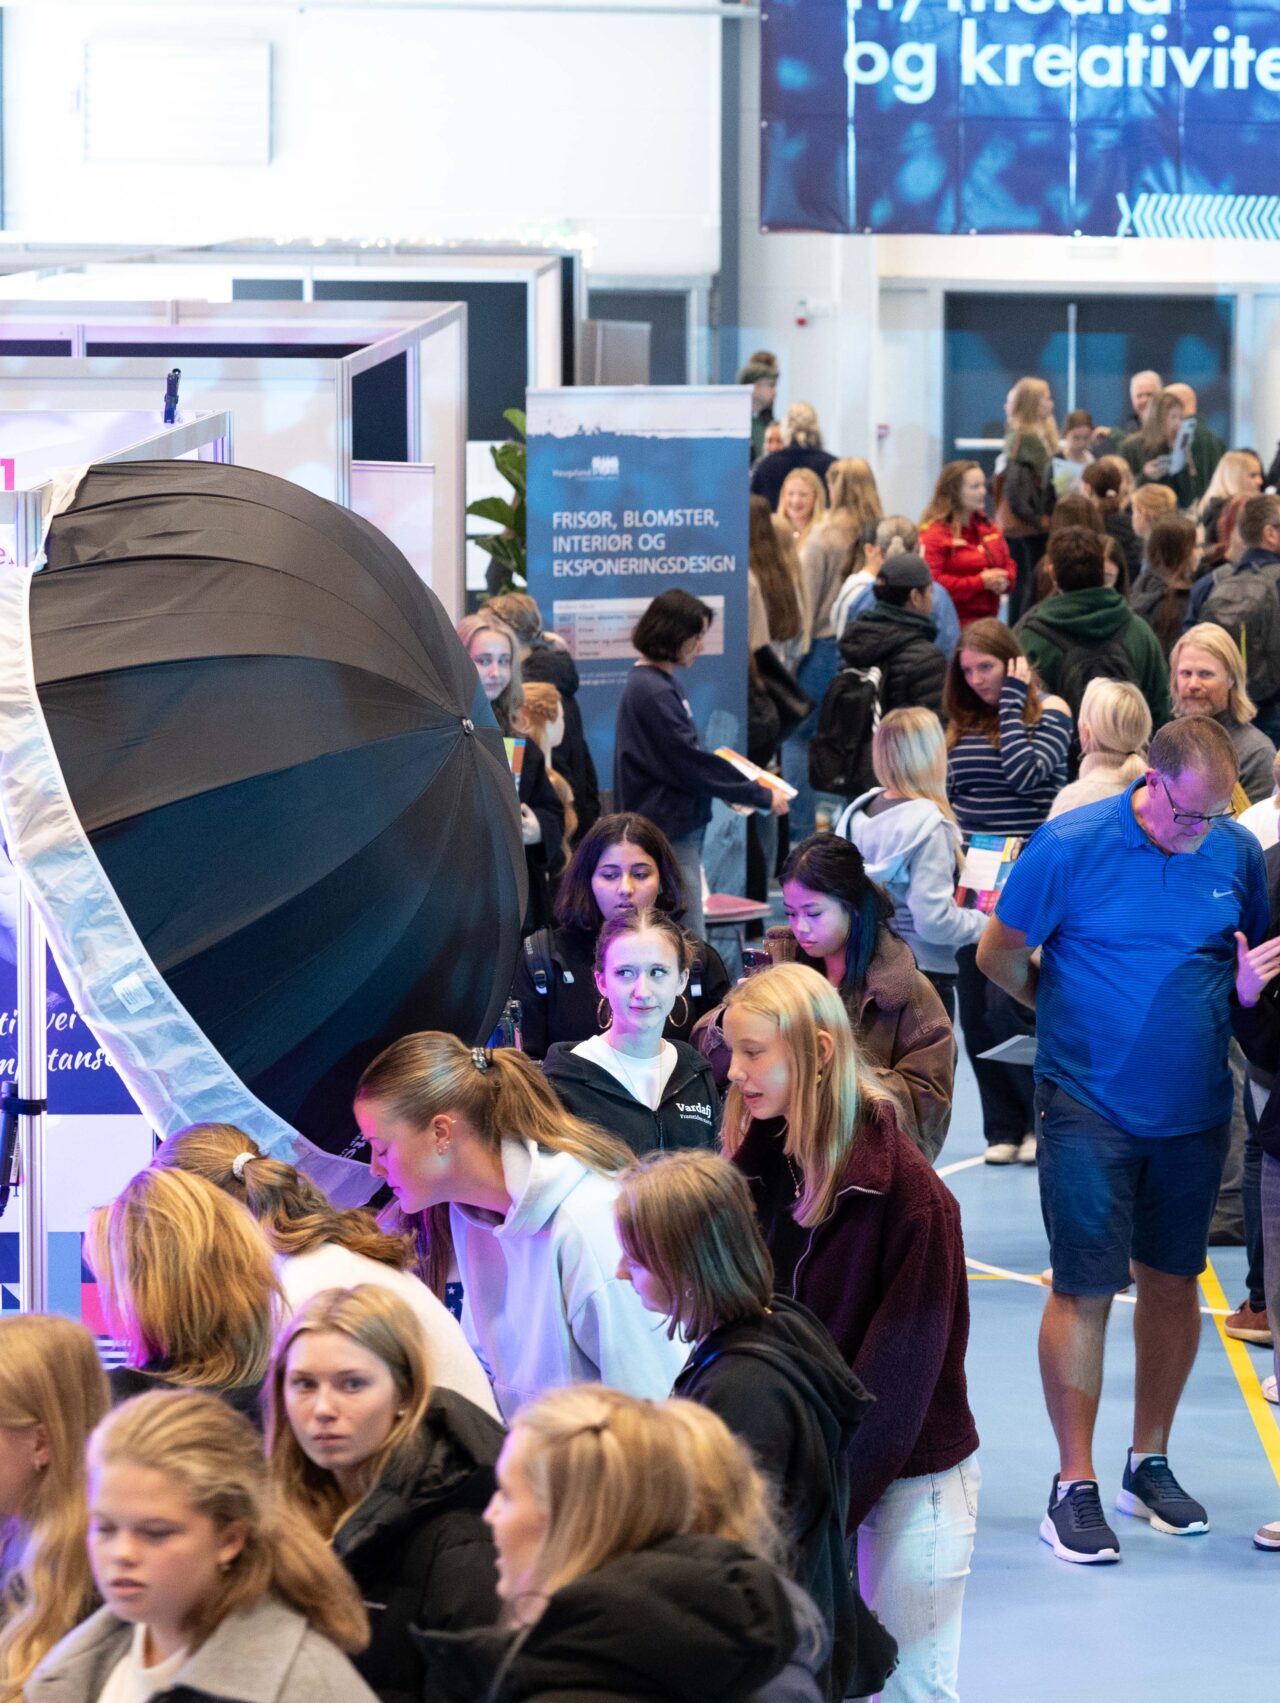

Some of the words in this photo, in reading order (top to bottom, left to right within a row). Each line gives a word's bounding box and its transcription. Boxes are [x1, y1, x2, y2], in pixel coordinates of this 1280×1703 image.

[844, 41, 937, 103] og
[553, 511, 618, 530] FRISØR,
[623, 509, 720, 528] BLOMSTER,
[553, 535, 633, 553] INTERIØR
[638, 533, 666, 551] OG
[553, 555, 736, 577] EKSPONERINGSDESIGN
